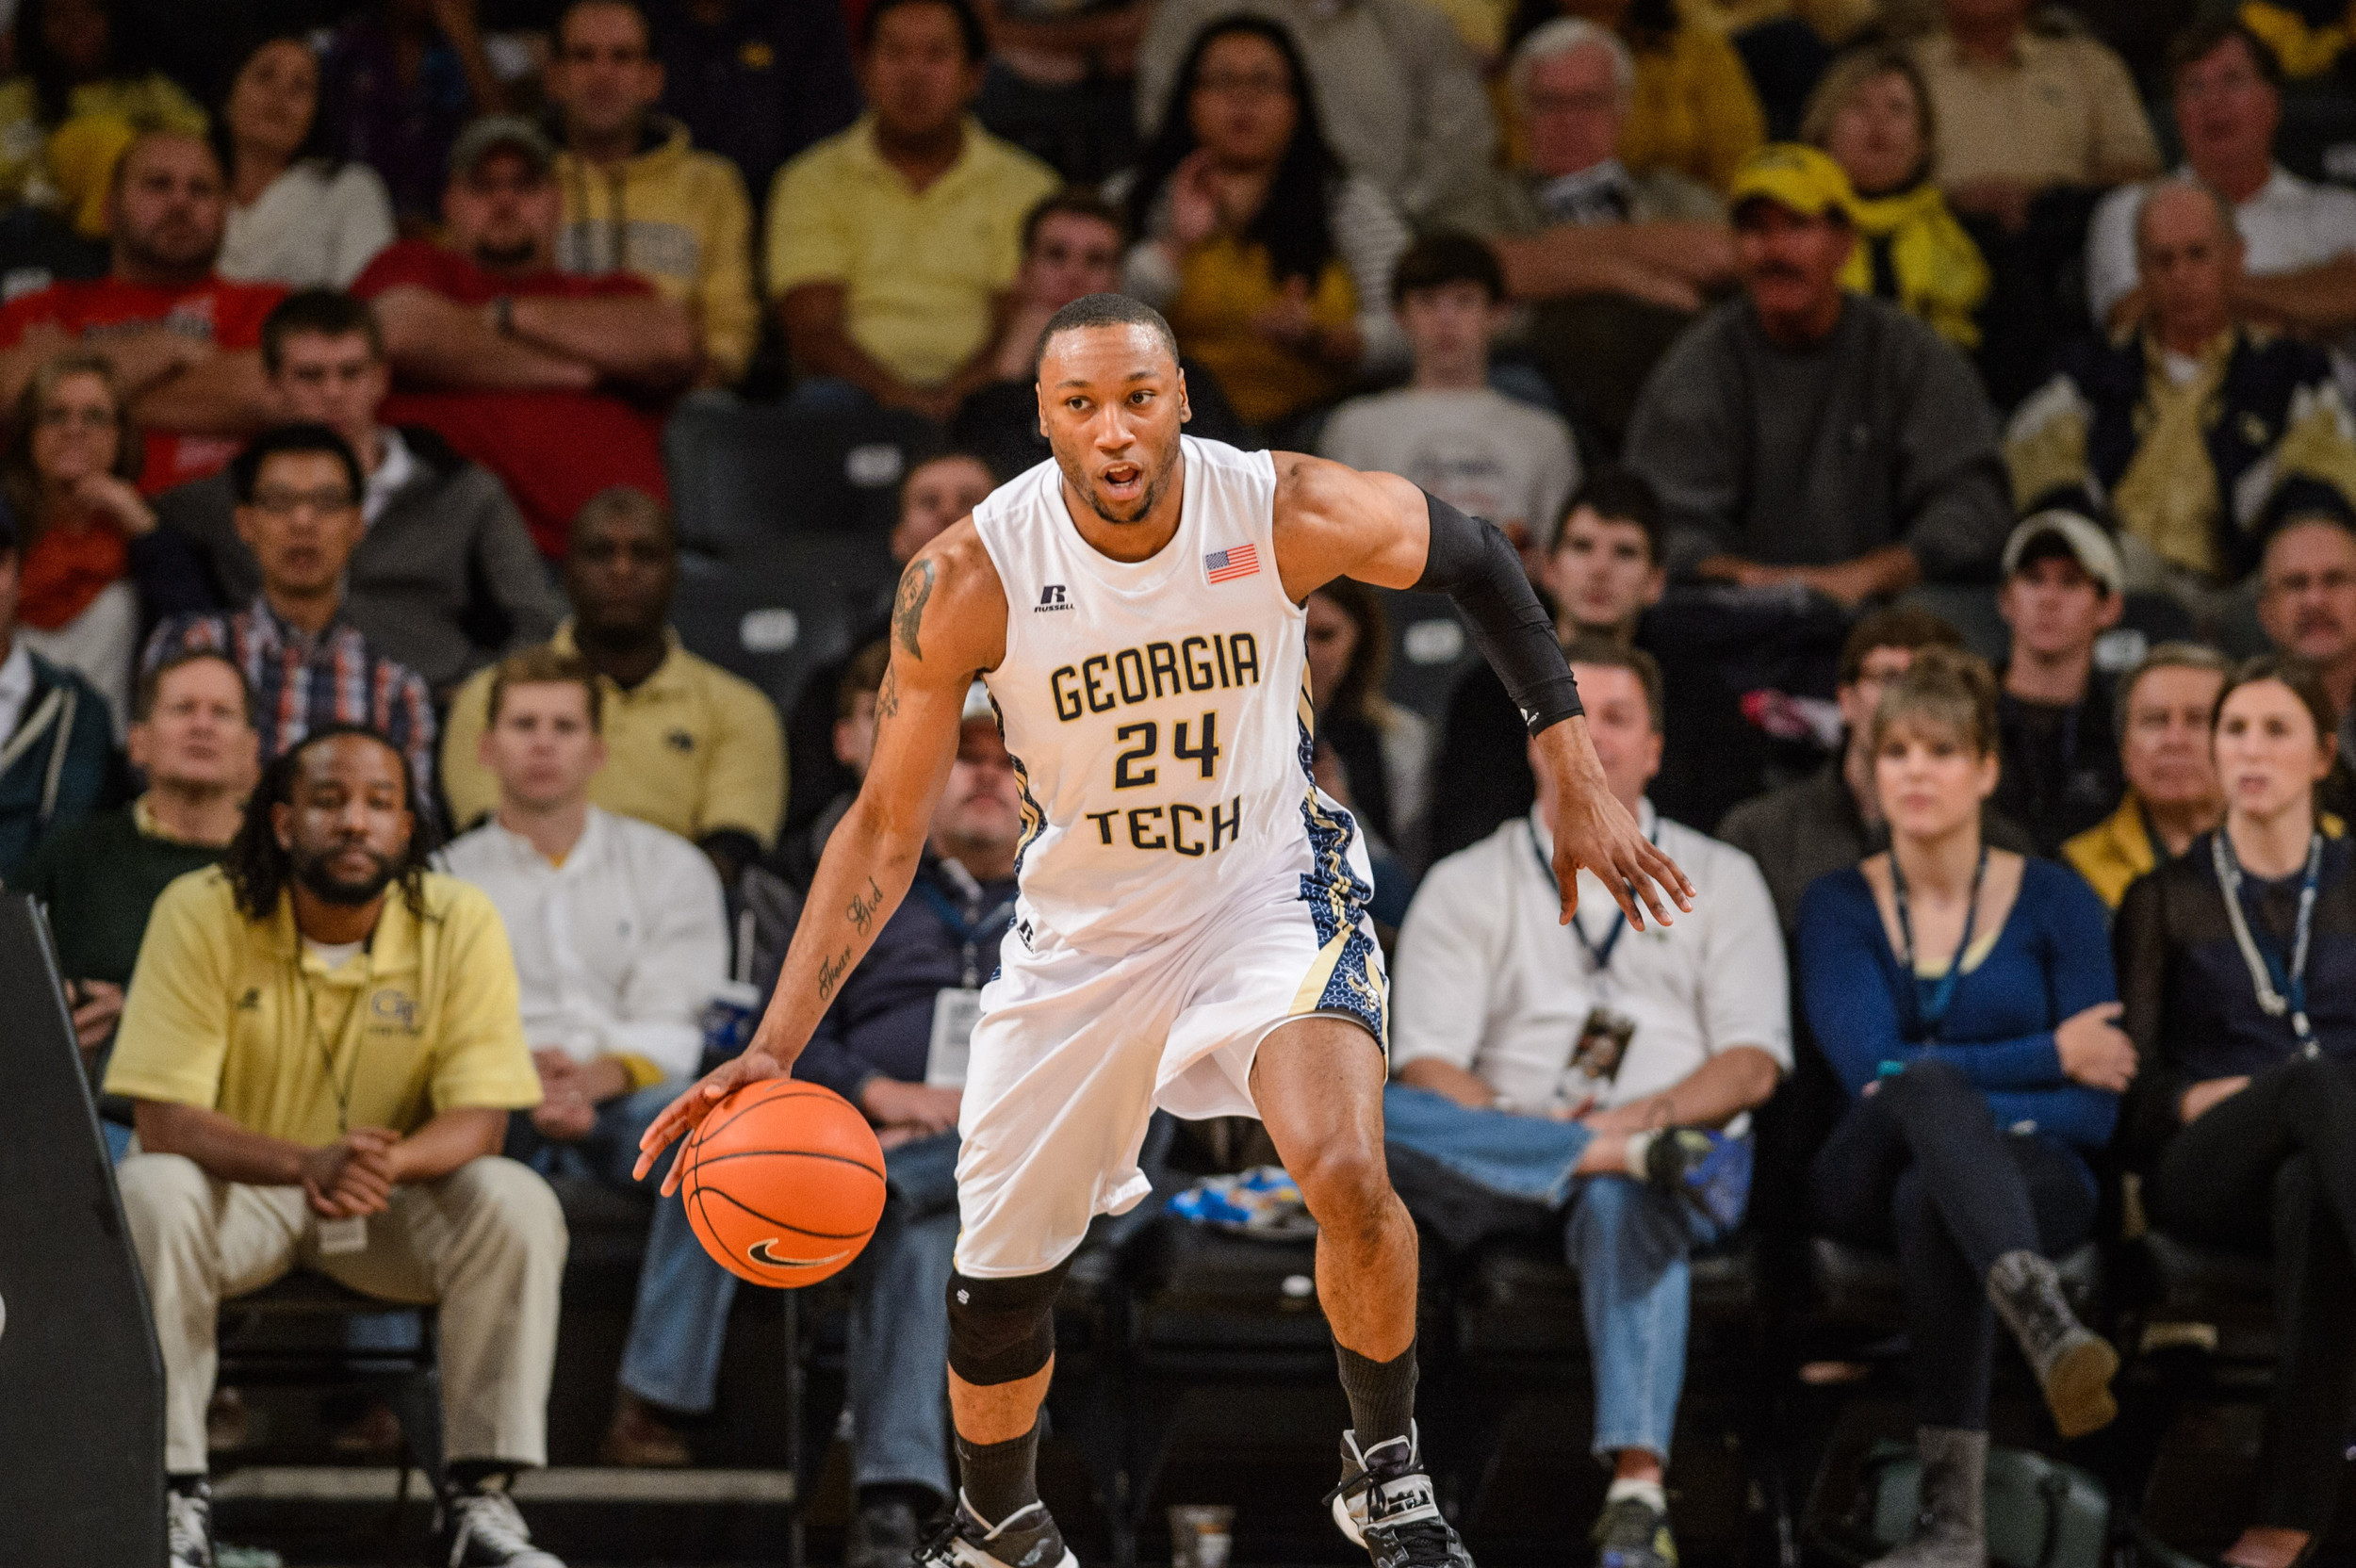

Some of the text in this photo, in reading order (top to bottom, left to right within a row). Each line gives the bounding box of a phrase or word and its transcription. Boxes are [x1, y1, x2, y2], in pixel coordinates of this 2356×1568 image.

[1034, 603, 1075, 613] RUSSELL
[1040, 585, 1066, 604] R
[1049, 632, 1260, 724] GEORGIA
[1112, 710, 1220, 792] 24
[1085, 794, 1241, 858] TECH
[846, 875, 884, 938] God
